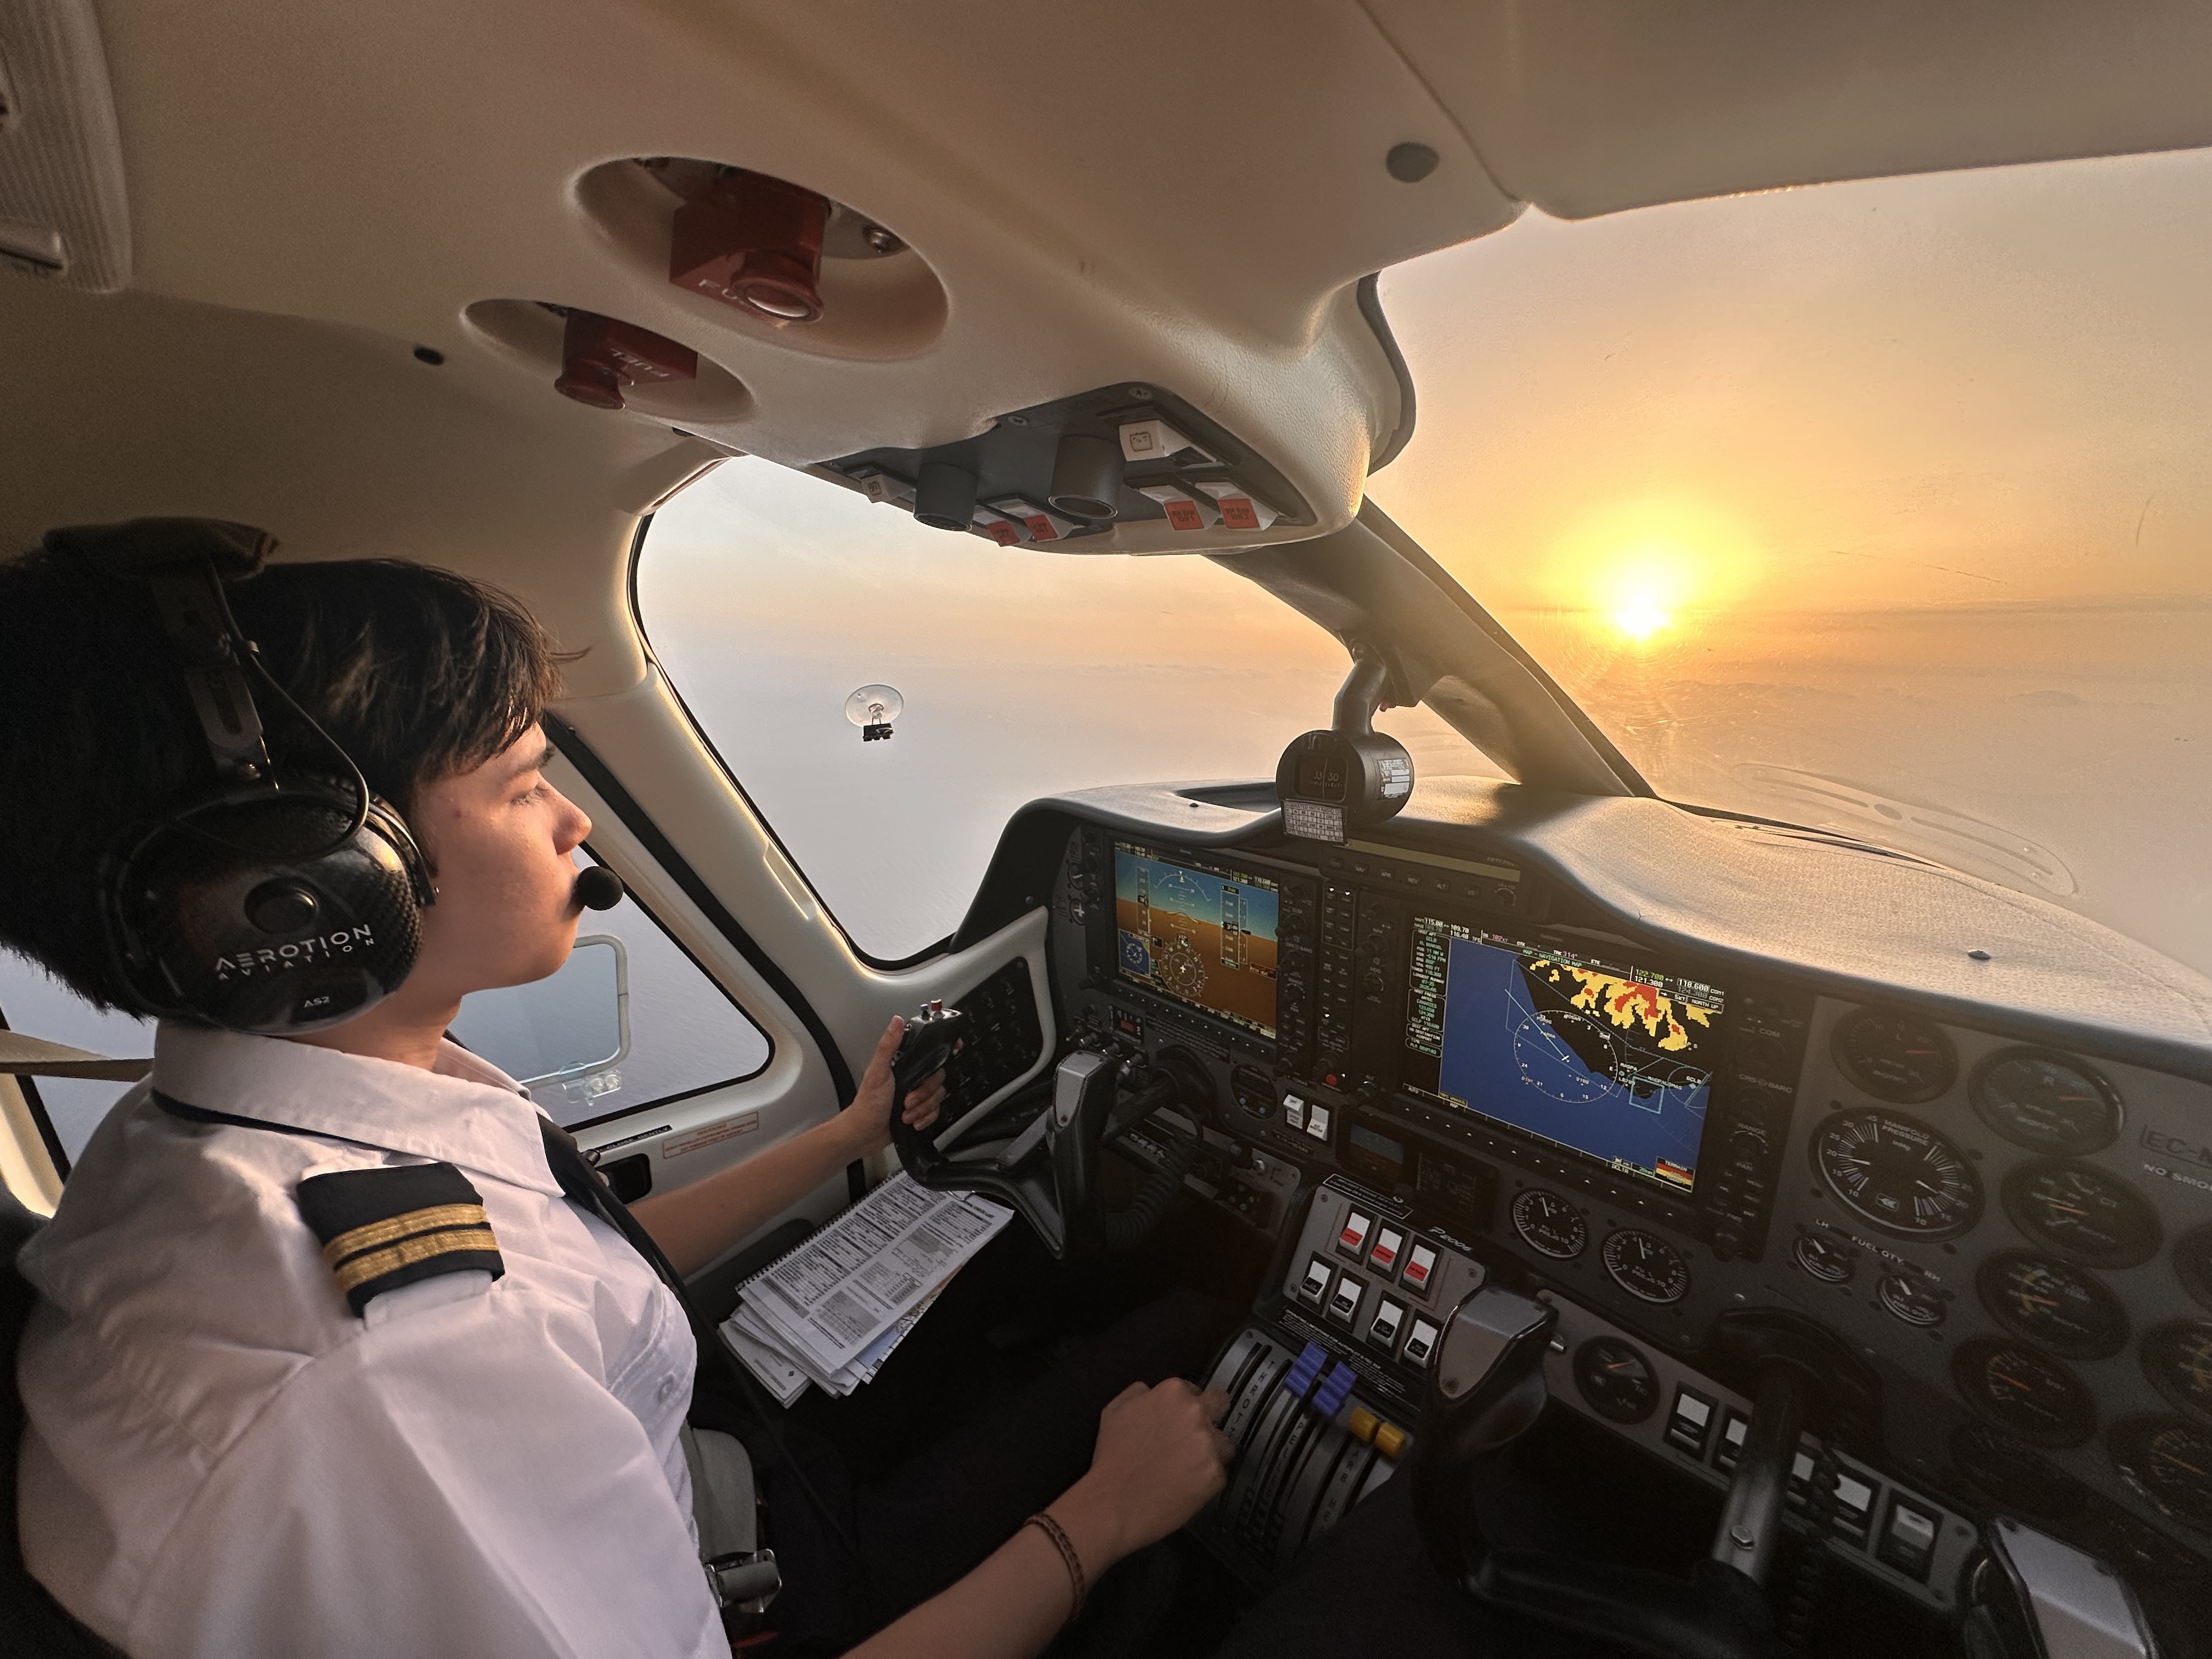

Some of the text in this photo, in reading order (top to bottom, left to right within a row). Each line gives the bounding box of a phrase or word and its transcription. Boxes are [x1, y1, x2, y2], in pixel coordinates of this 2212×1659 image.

[1328, 772, 1339, 782] 30
[1450, 924, 1469, 933] 109.70
[1450, 930, 1469, 939] 116.40
[215, 923, 372, 972] AEROTION
[219, 937, 374, 980] AVIATION
[1539, 952, 1570, 966] NAVIGATION
[1634, 968, 1725, 996] 122.700 118.600 COM1
[1634, 975, 1724, 1003] 121.300 124.300 COM2
[1691, 998, 1709, 1007] NORTH
[1415, 1029, 1441, 1041] DESTINATION
[1759, 1028, 1780, 1038] COM
[1620, 1062, 1638, 1071] MASPA
[1647, 1075, 1683, 1091] MASPALOMAS
[1739, 1074, 1793, 1094] CRS BARO
[1737, 1122, 1767, 1137] RANGE
[1842, 1120, 1854, 1128] 30
[1883, 1119, 1930, 1140] MANIFOLD
[1829, 1132, 1841, 1141] 25
[1881, 1125, 1929, 1147] PRESSURE
[1826, 1148, 1838, 1157] 20
[1664, 1160, 1688, 1172] TERRAIN
[1832, 1169, 1843, 1177] 15
[2143, 1163, 2212, 1192] NO SMO
[1848, 1188, 1859, 1198] 10
[1815, 1218, 1830, 1229] LH
[1915, 1217, 1927, 1226] 10
[1852, 1235, 1879, 1253] FUEL
[1285, 1308, 1307, 1324] OPERATING
[1306, 1322, 1330, 1338] LIMITATIONS
[1338, 1342, 1361, 1357] AUTOPILOT
